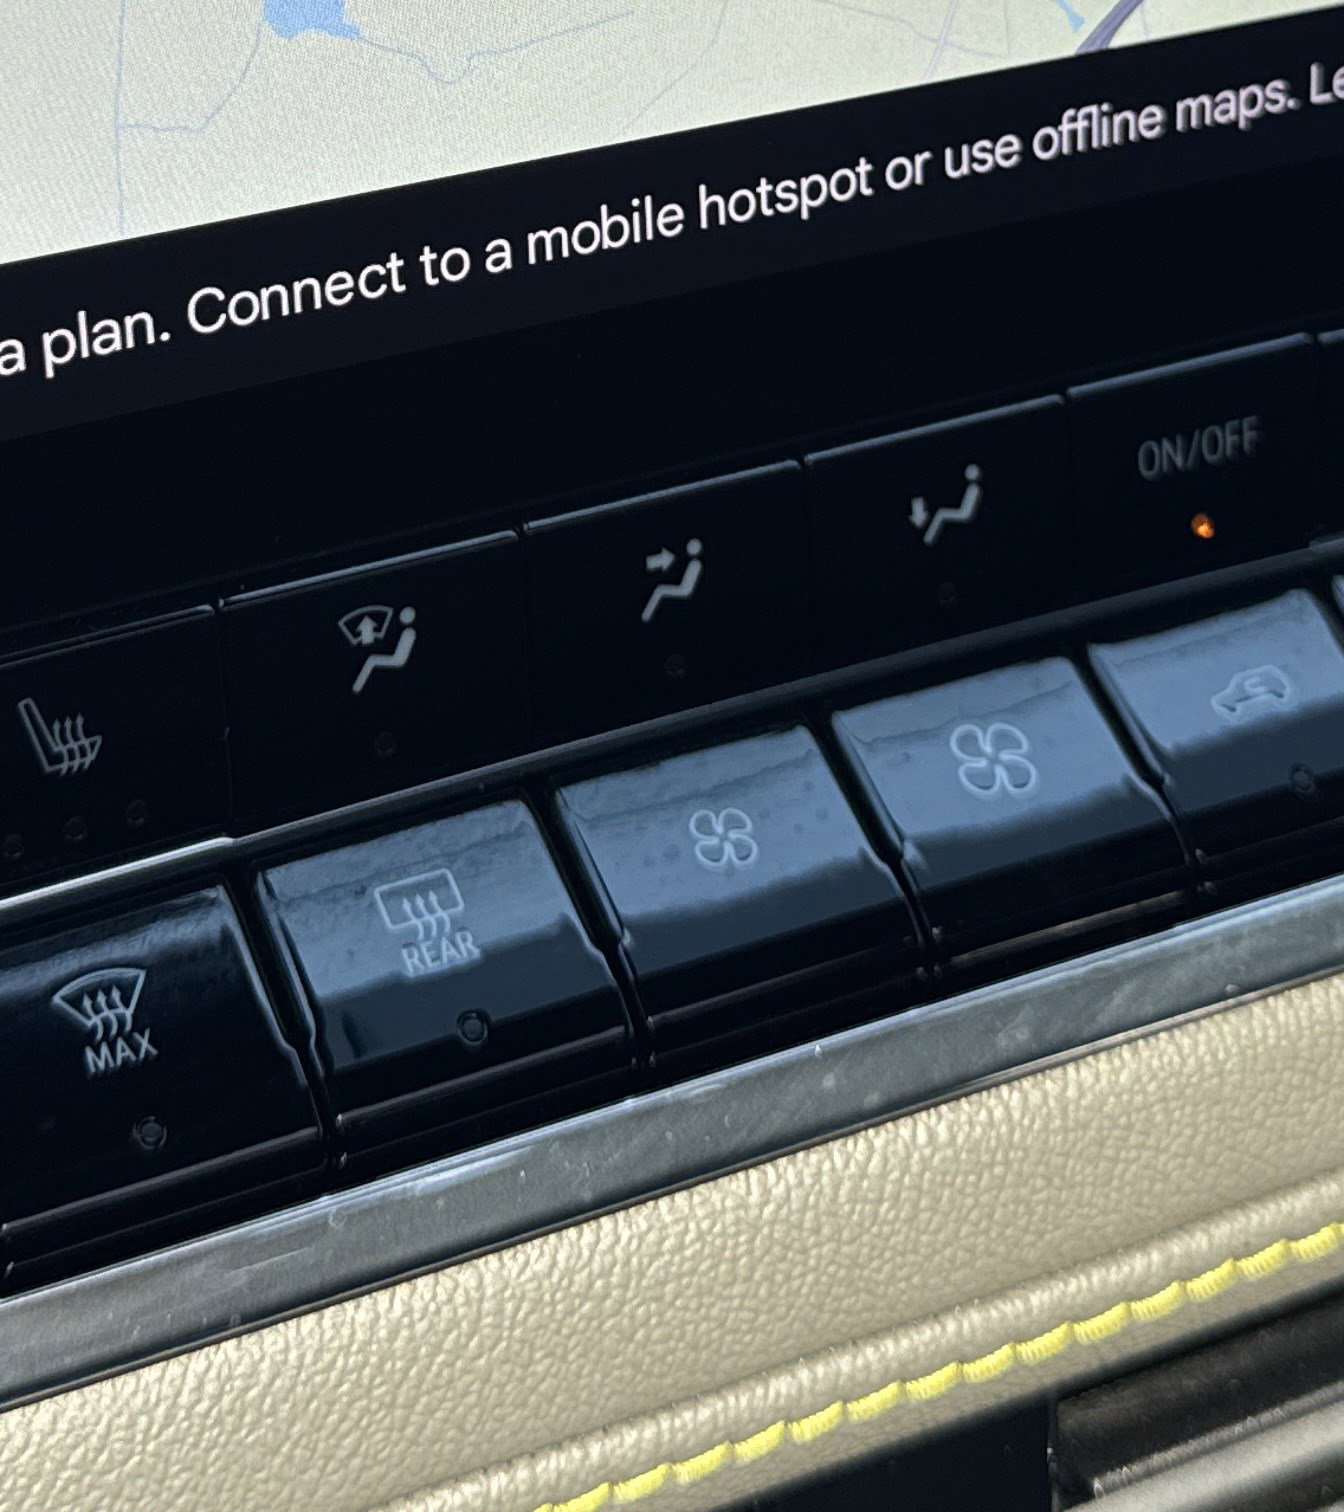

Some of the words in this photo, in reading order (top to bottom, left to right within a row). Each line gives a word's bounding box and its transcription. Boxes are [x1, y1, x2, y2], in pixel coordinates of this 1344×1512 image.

[42, 310, 172, 377] plan.
[186, 251, 407, 335] Connect
[419, 244, 472, 287] to
[484, 237, 514, 274] a
[525, 193, 685, 265] mobile
[698, 155, 874, 230] hotspot
[884, 150, 932, 191] or
[943, 129, 1024, 180] use
[1032, 101, 1168, 161] offline
[1175, 78, 1301, 131] maps.
[1138, 414, 1260, 481] ON/OFF
[401, 927, 480, 977] REAR
[83, 1028, 159, 1076] MAX
